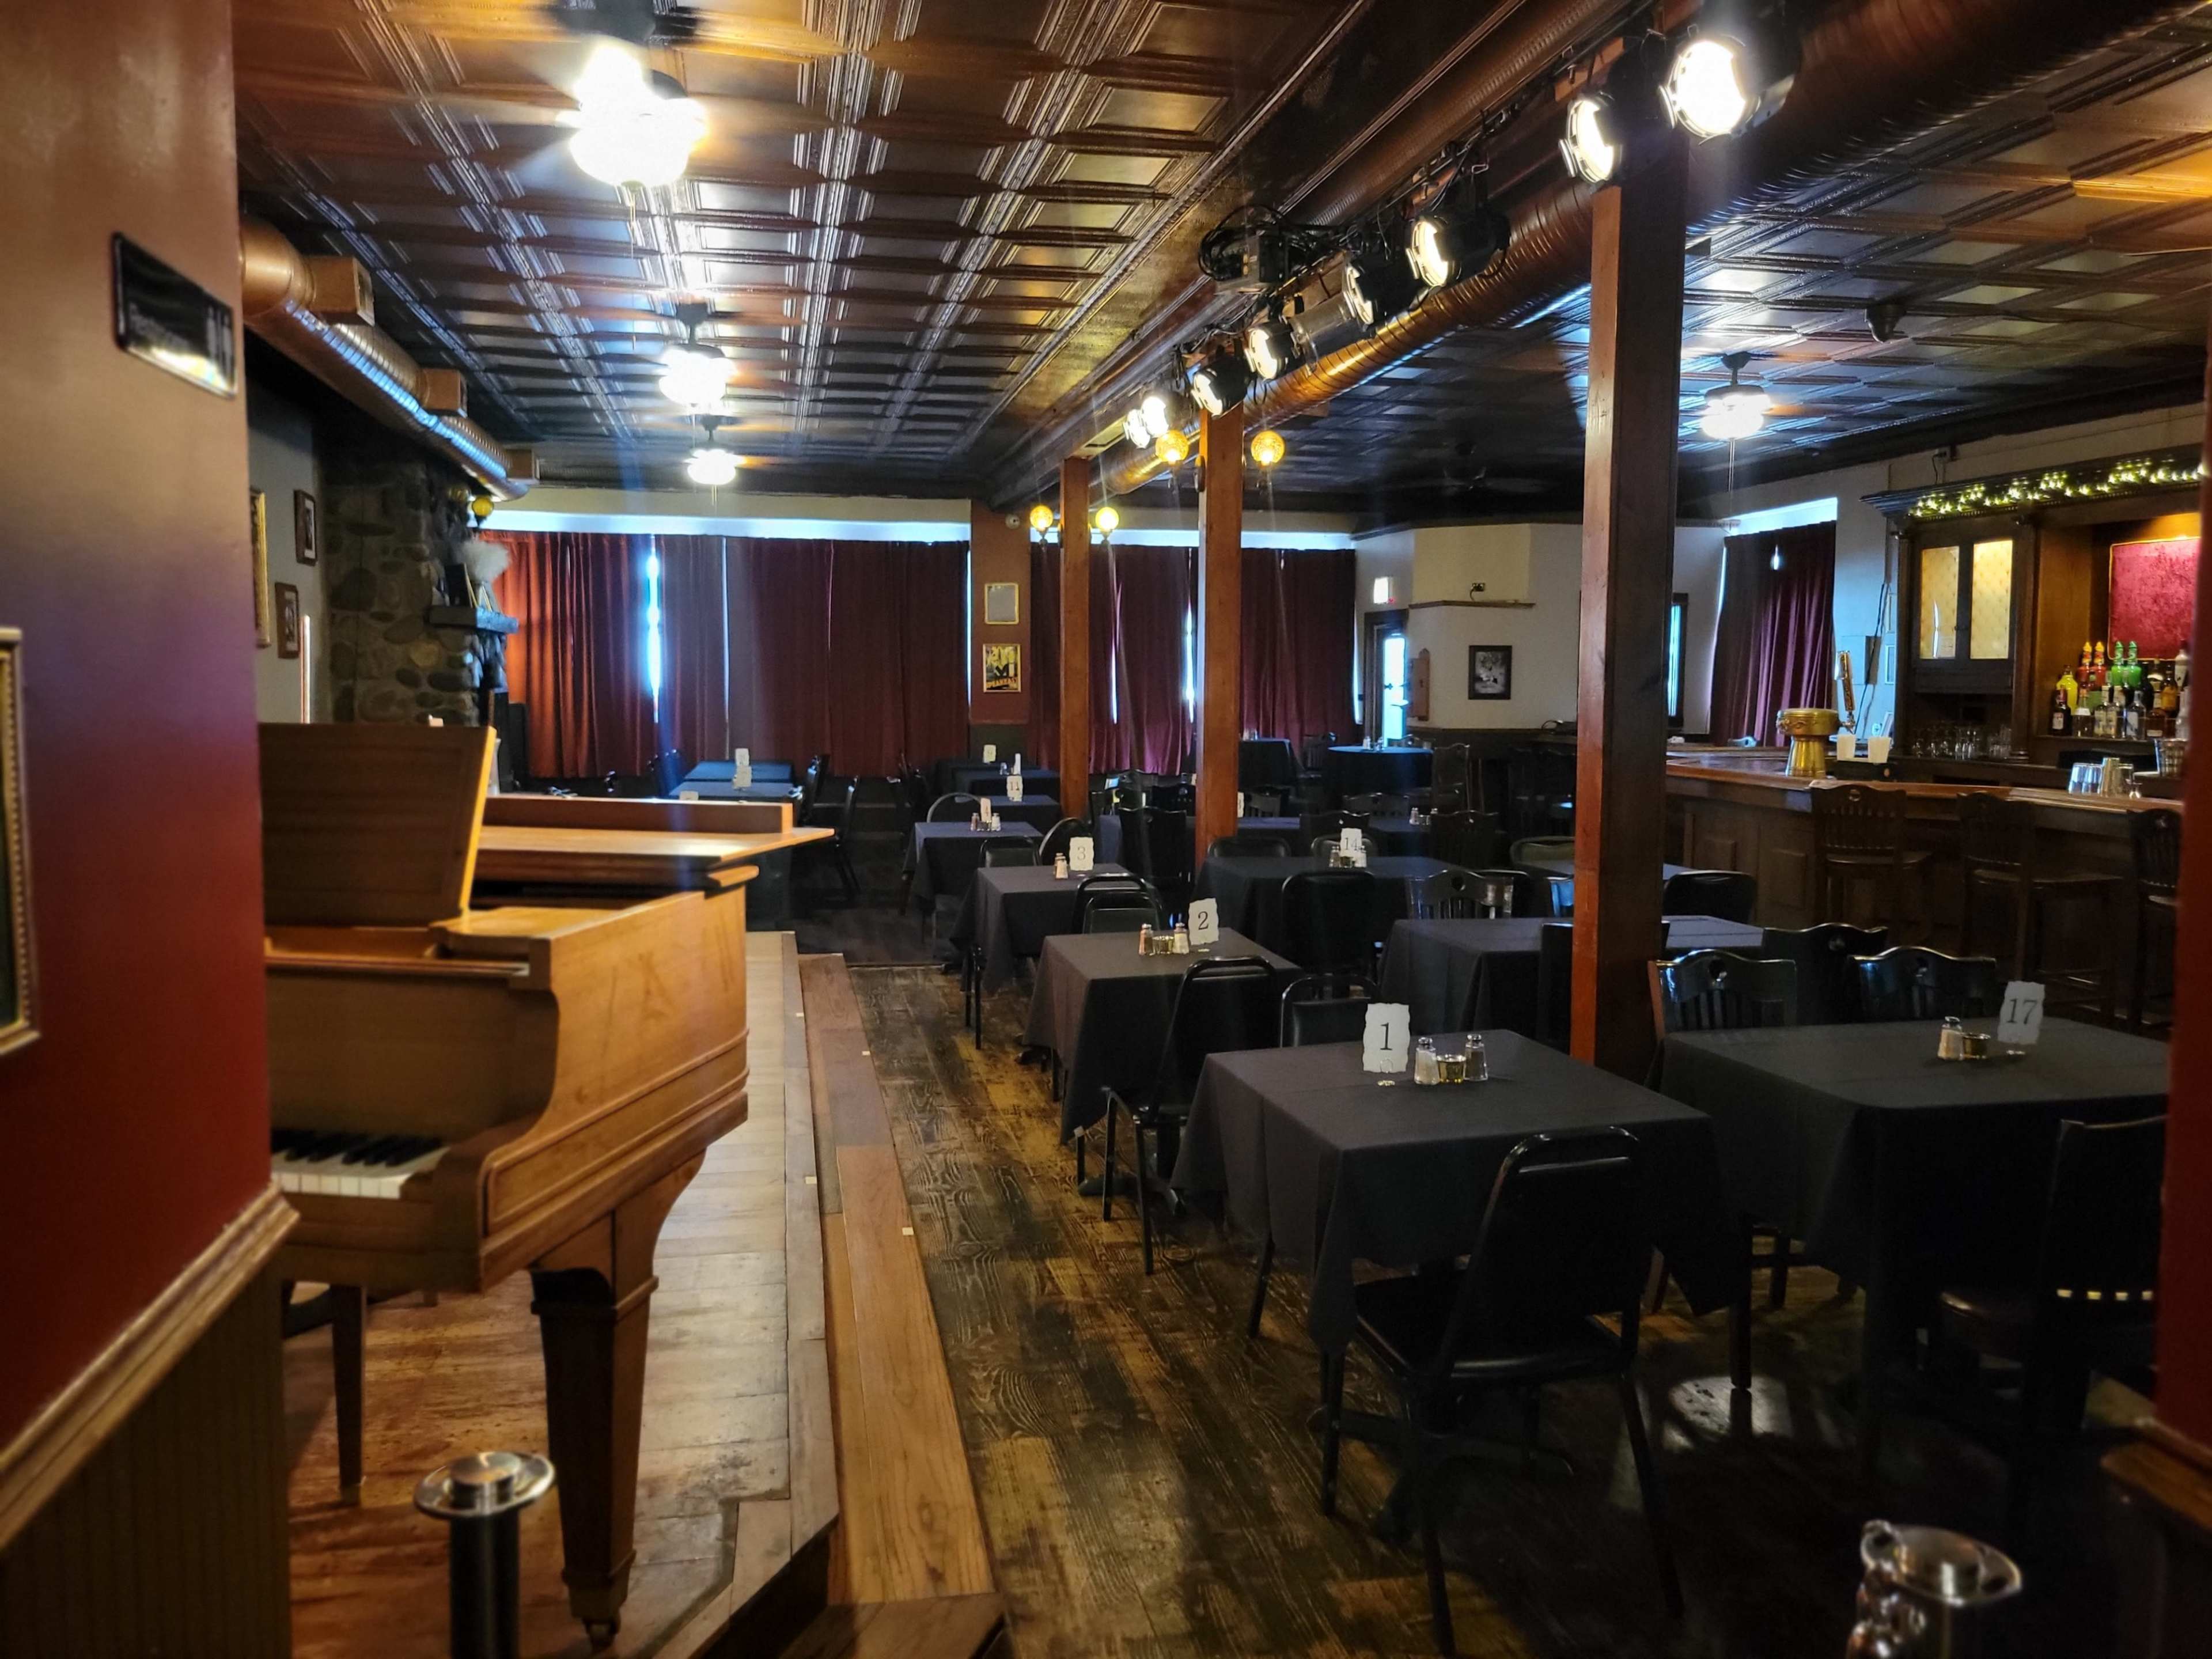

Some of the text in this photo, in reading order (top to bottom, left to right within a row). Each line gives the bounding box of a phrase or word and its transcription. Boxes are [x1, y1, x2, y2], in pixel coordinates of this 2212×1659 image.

[1077, 846, 1086, 861] 3
[1198, 911, 1209, 931] 2
[2006, 998, 2038, 1025] 17
[1380, 1022, 1393, 1051] 1
